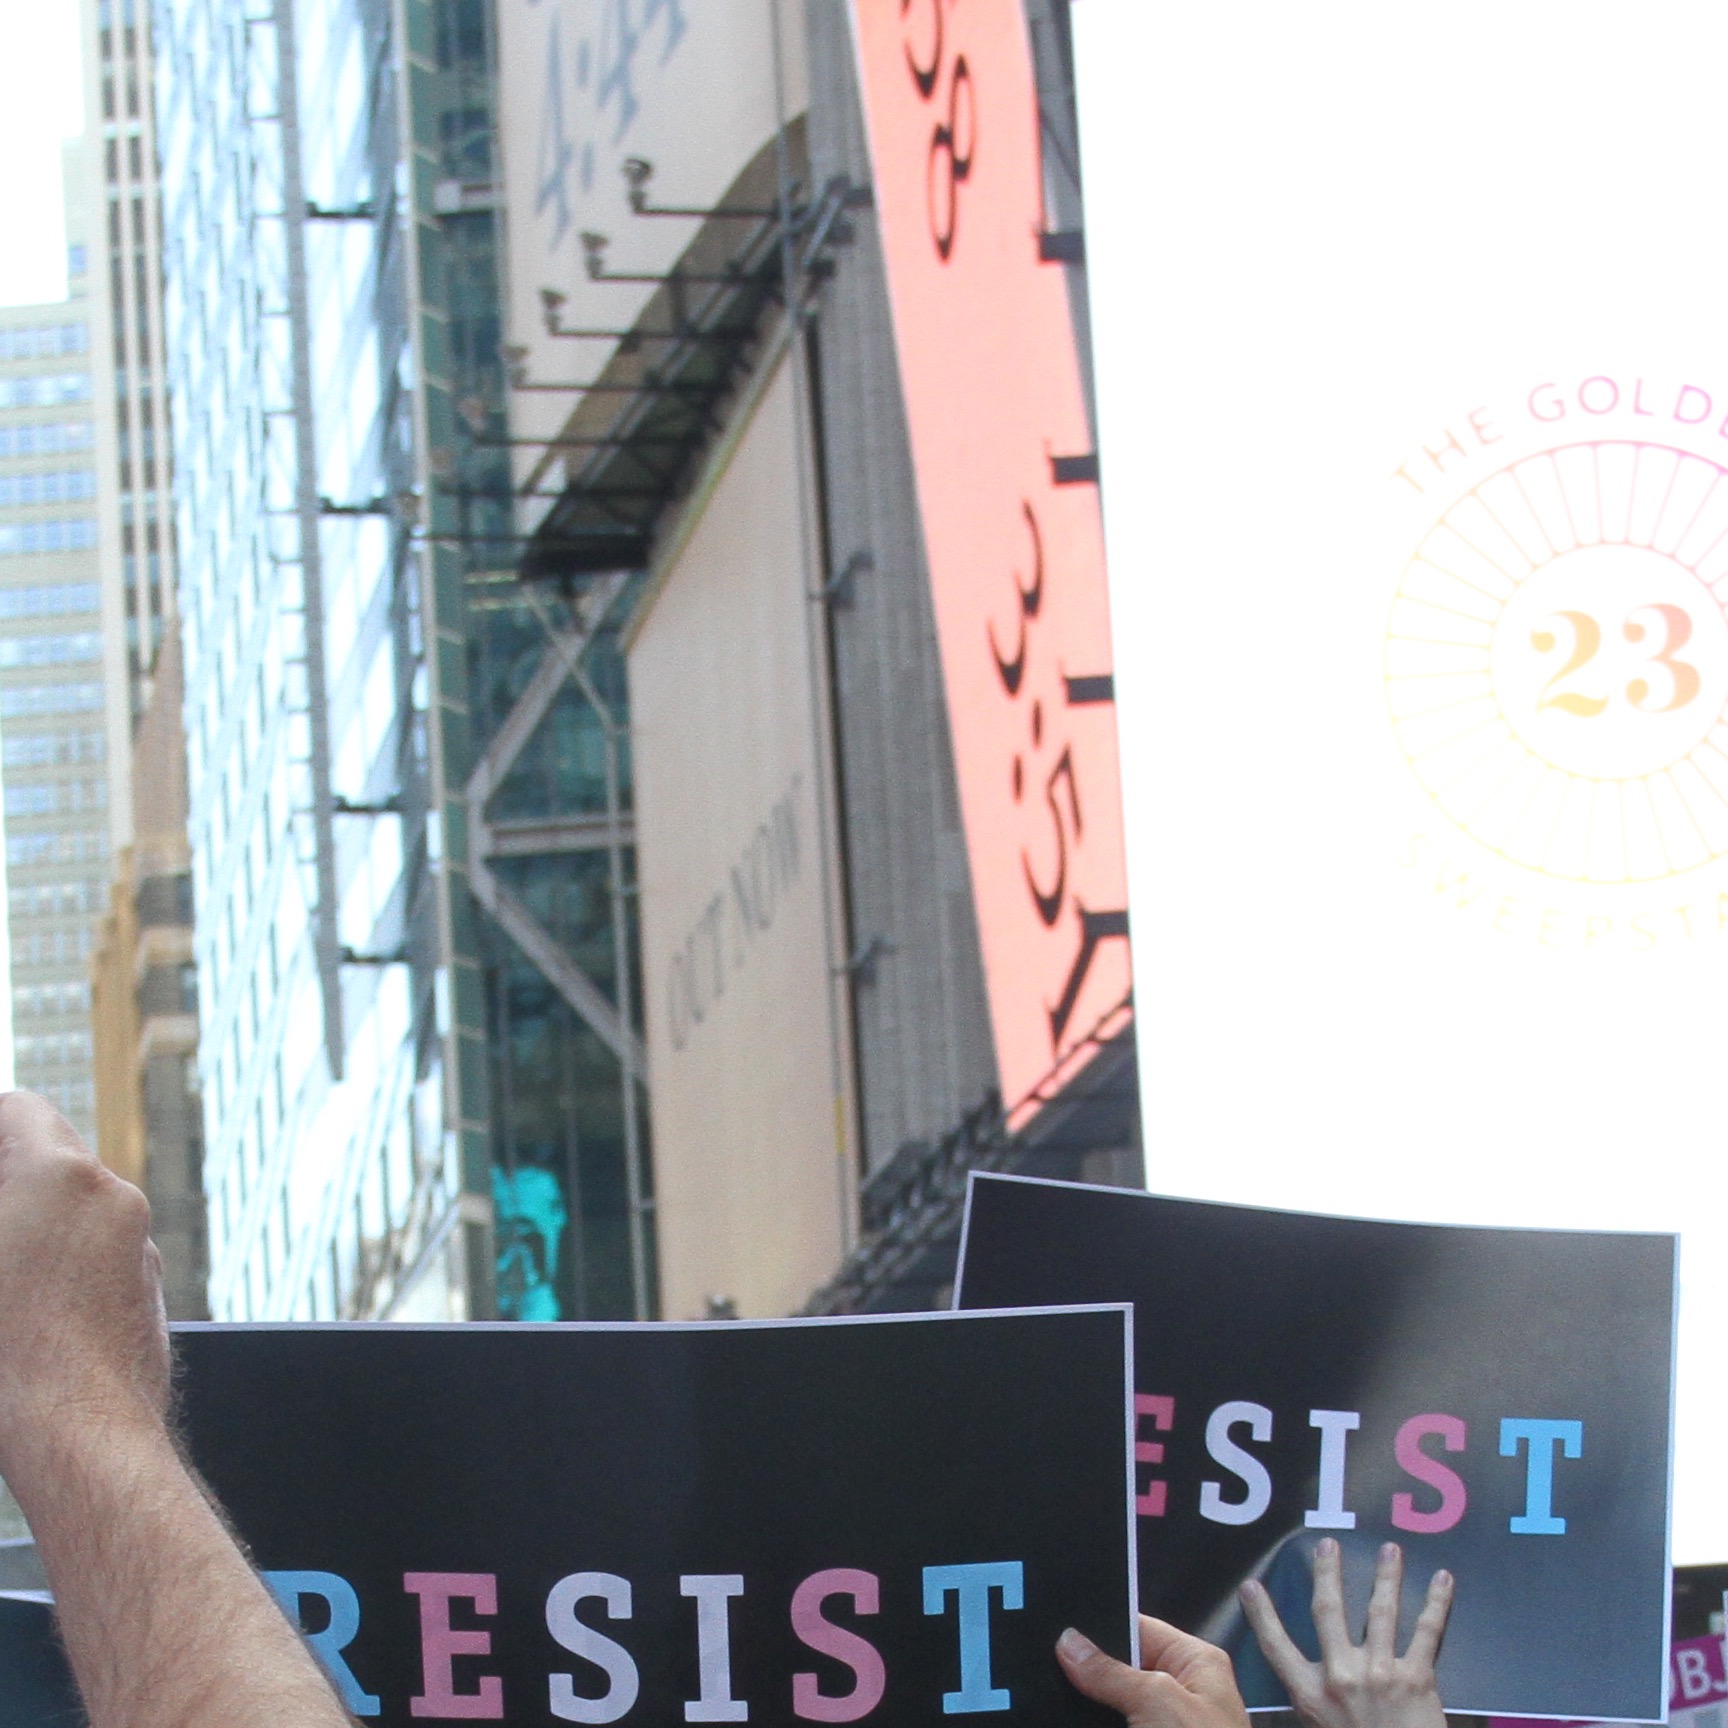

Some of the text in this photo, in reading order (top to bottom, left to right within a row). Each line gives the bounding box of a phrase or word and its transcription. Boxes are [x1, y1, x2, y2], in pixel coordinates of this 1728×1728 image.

[1389, 404, 1504, 495] THE
[1529, 601, 1702, 718] 23
[260, 1560, 1024, 1725] RESIST
